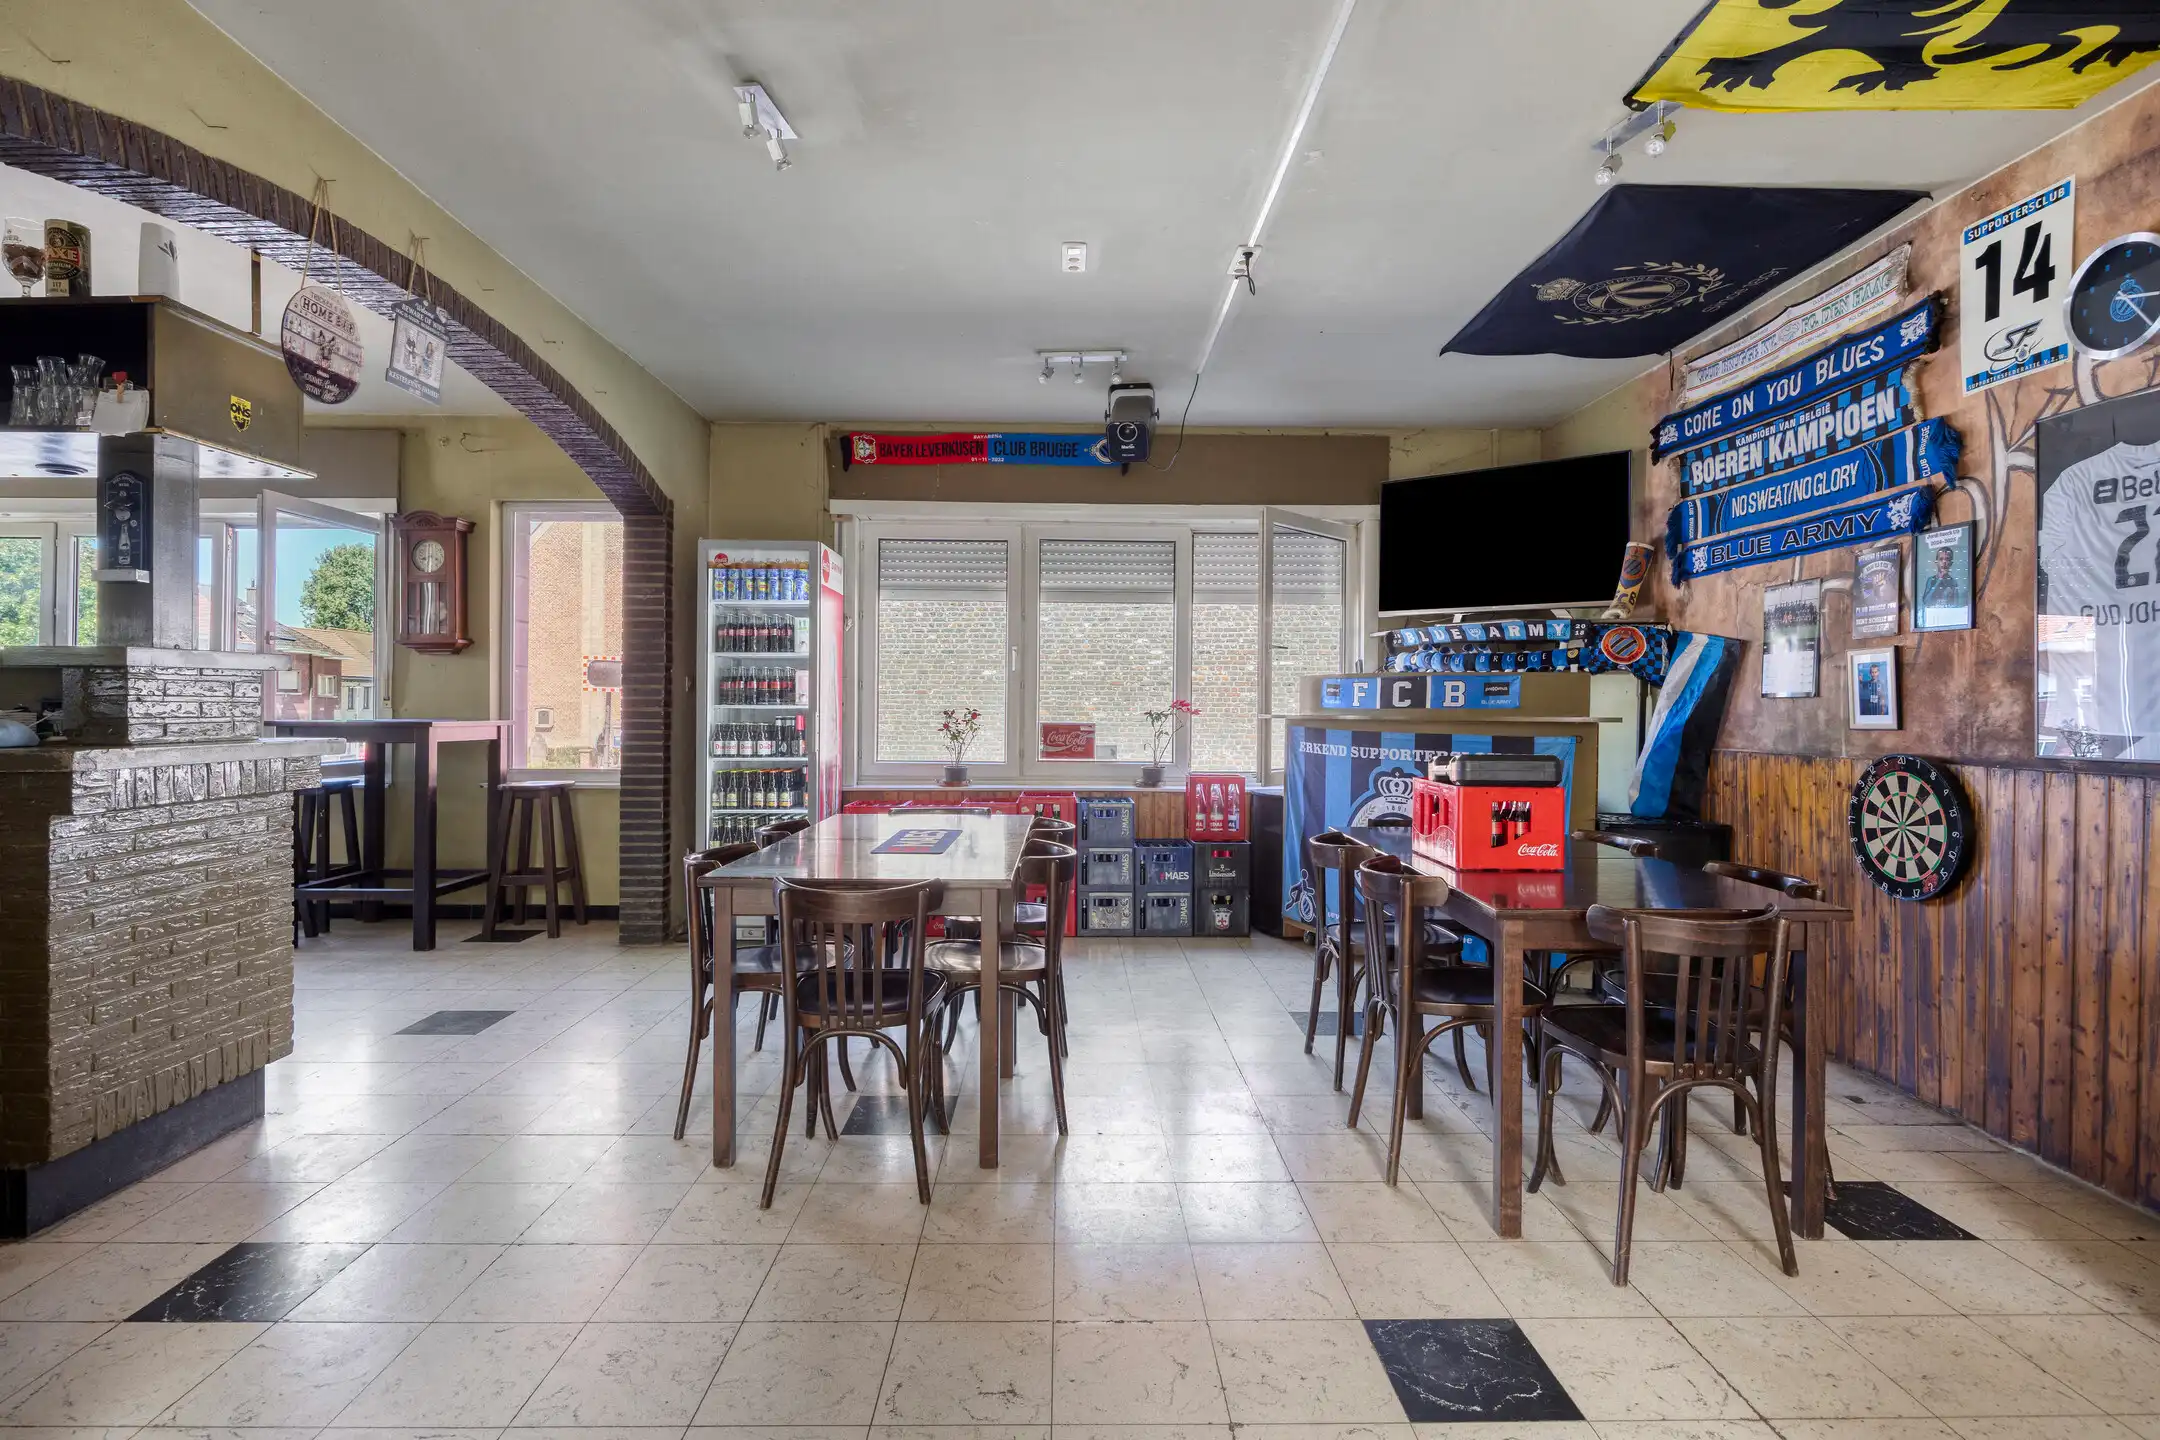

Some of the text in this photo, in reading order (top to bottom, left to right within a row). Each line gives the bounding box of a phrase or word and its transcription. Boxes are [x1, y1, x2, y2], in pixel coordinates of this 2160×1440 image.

[1967, 186, 2065, 241] SUPPORTERSCLUB
[1975, 220, 2056, 322] 14
[303, 298, 333, 323] HOME
[1684, 405, 1722, 437] COME
[1732, 391, 1754, 419] ON
[1767, 371, 1803, 406] YOU
[1815, 335, 1886, 387] BLUES
[1691, 386, 1897, 487] BOEREN KAMPIOEN
[1735, 401, 1832, 448] KAMPIOEN VAN BELGIË
[879, 440, 1079, 458] BAYER LEVERKUSEN CLUB BRUGGE
[1919, 425, 1931, 478] CLUB BRUGGE
[1813, 459, 1860, 498] GLORY
[1710, 509, 1881, 566] BLUE ARMY
[1405, 623, 1567, 644] BLUE ARMY
[1299, 741, 1347, 757] ERKEND
[1898, 756, 1907, 765] 20
[1517, 843, 1559, 857] Coca-Cola
[1165, 871, 1189, 880] MAES
[1180, 897, 1188, 919] MAES
